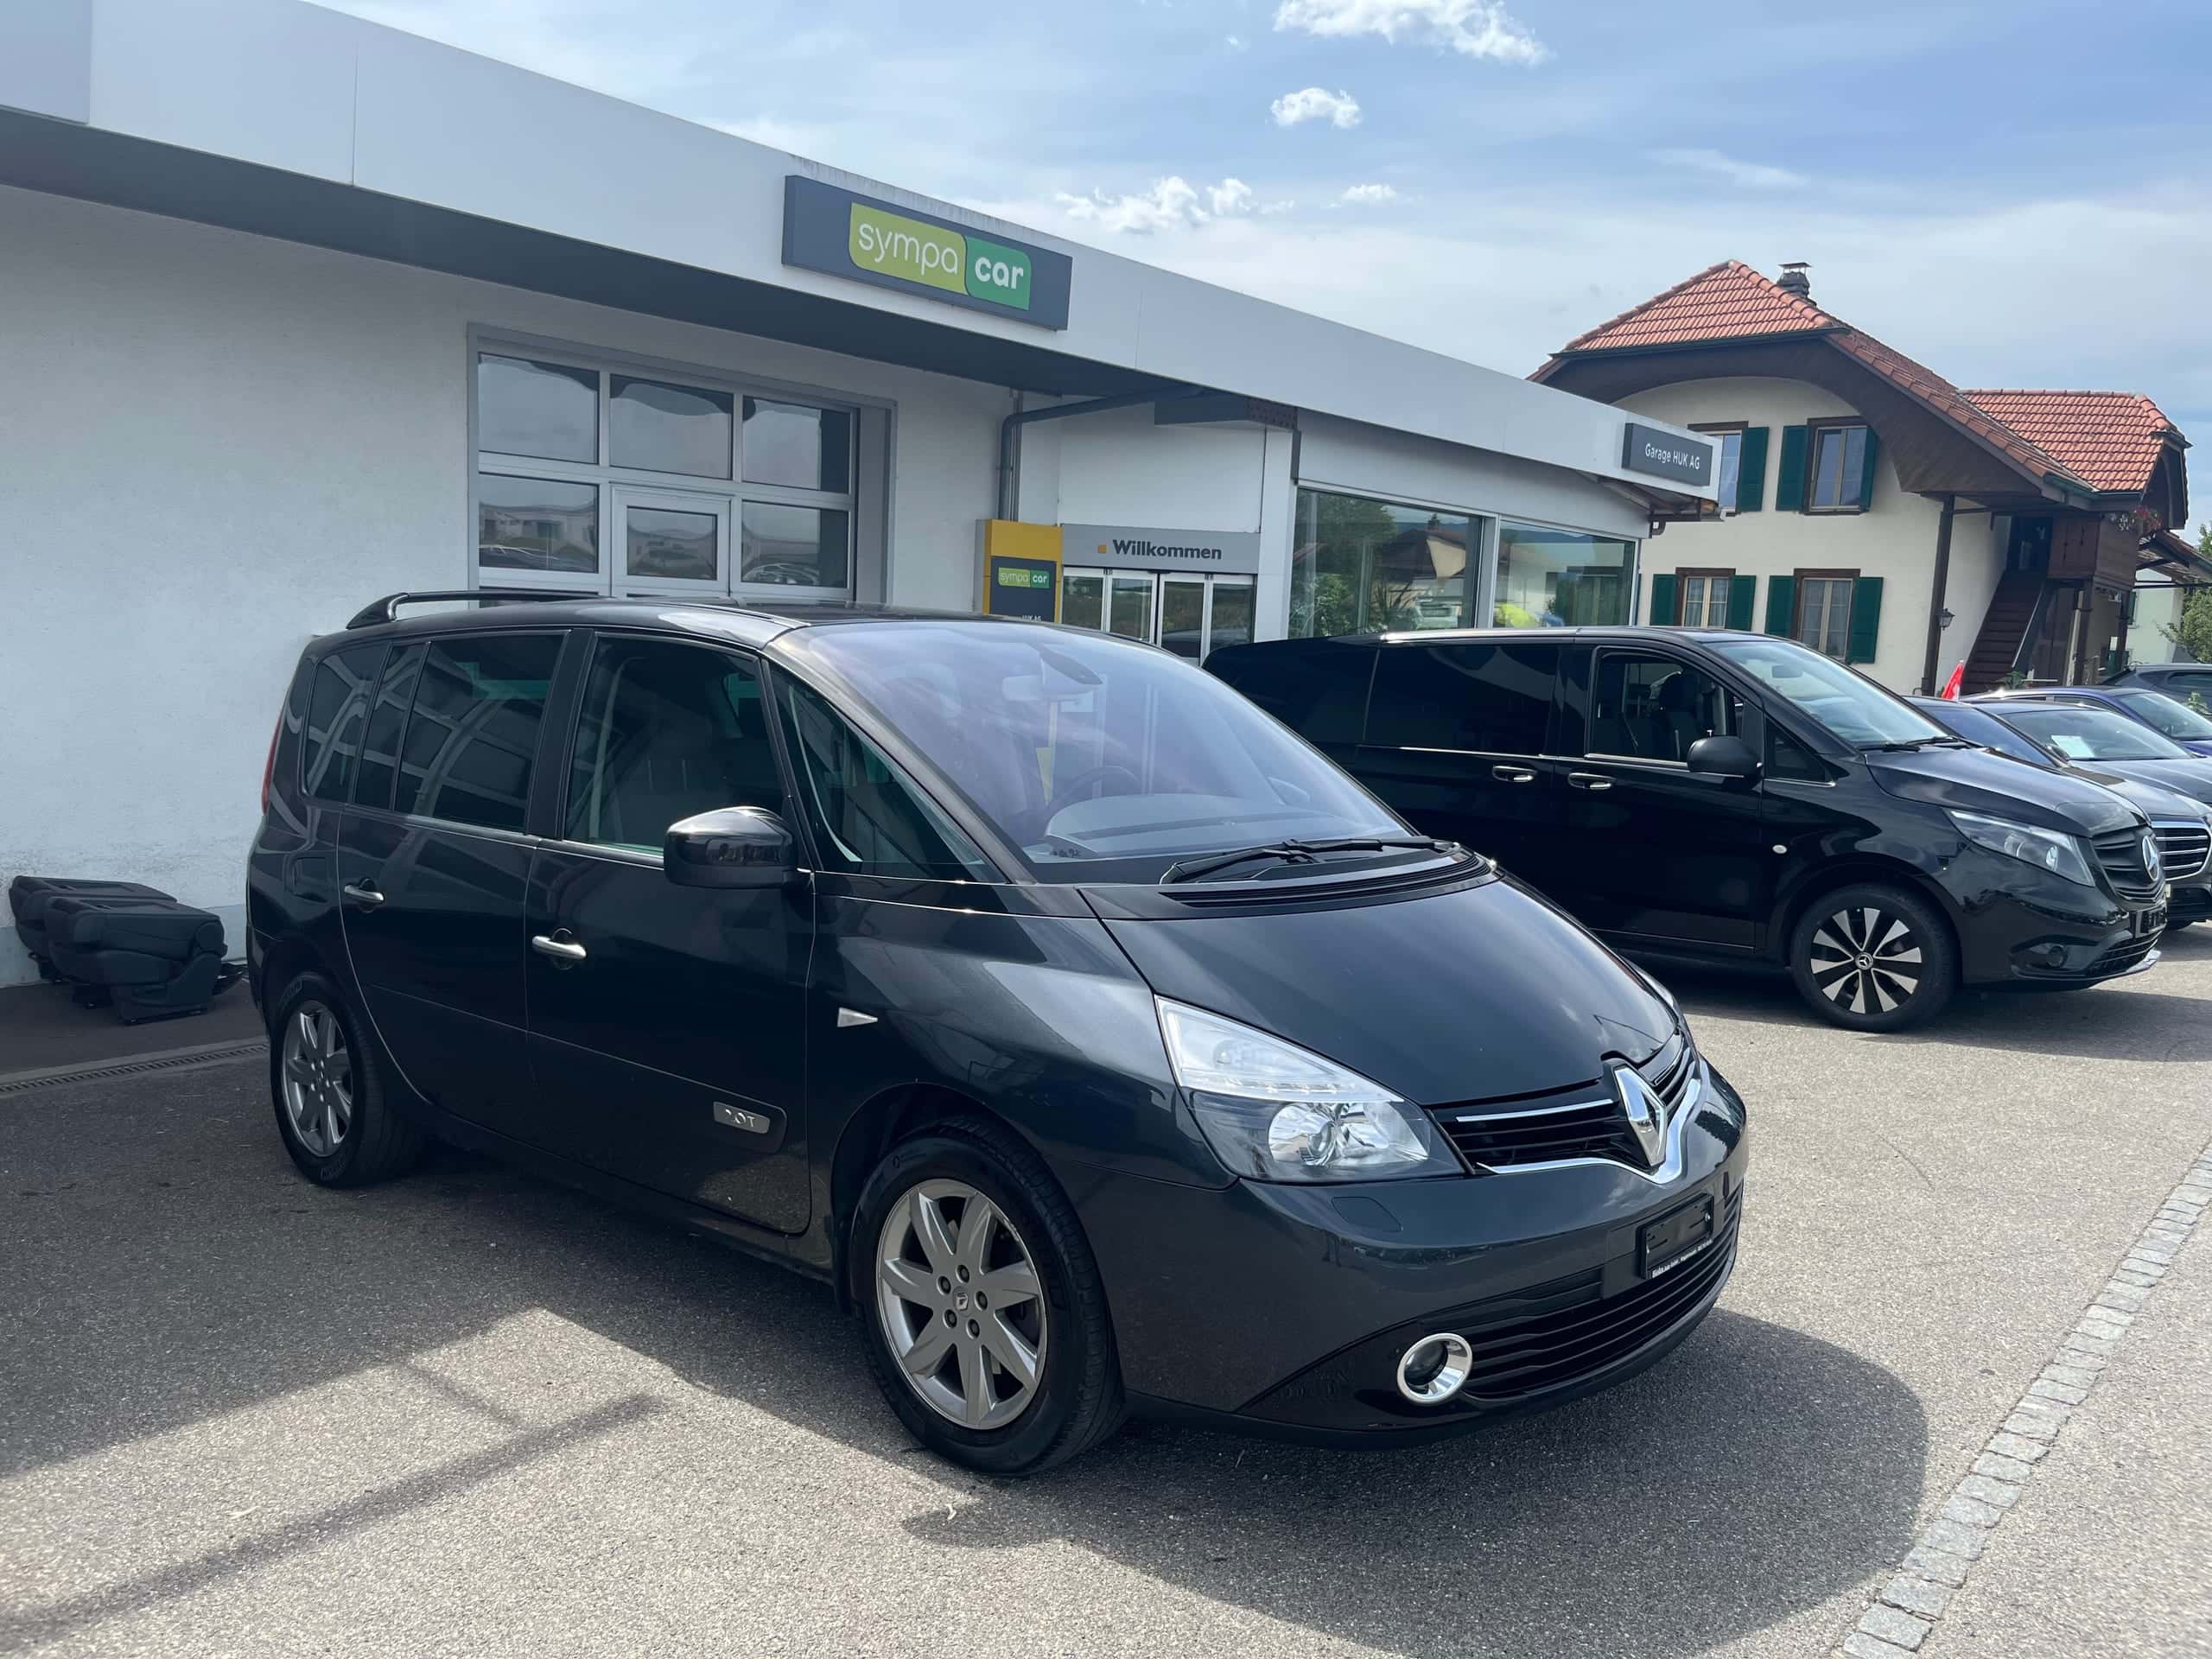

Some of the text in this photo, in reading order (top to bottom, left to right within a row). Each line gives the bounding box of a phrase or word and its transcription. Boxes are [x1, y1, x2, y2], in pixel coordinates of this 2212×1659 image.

[858, 223, 1025, 290] sympa car
[1644, 442, 1700, 470] Garage HUK AG
[1112, 538, 1223, 561] Willkommen
[1001, 572, 1048, 585] sympa car
